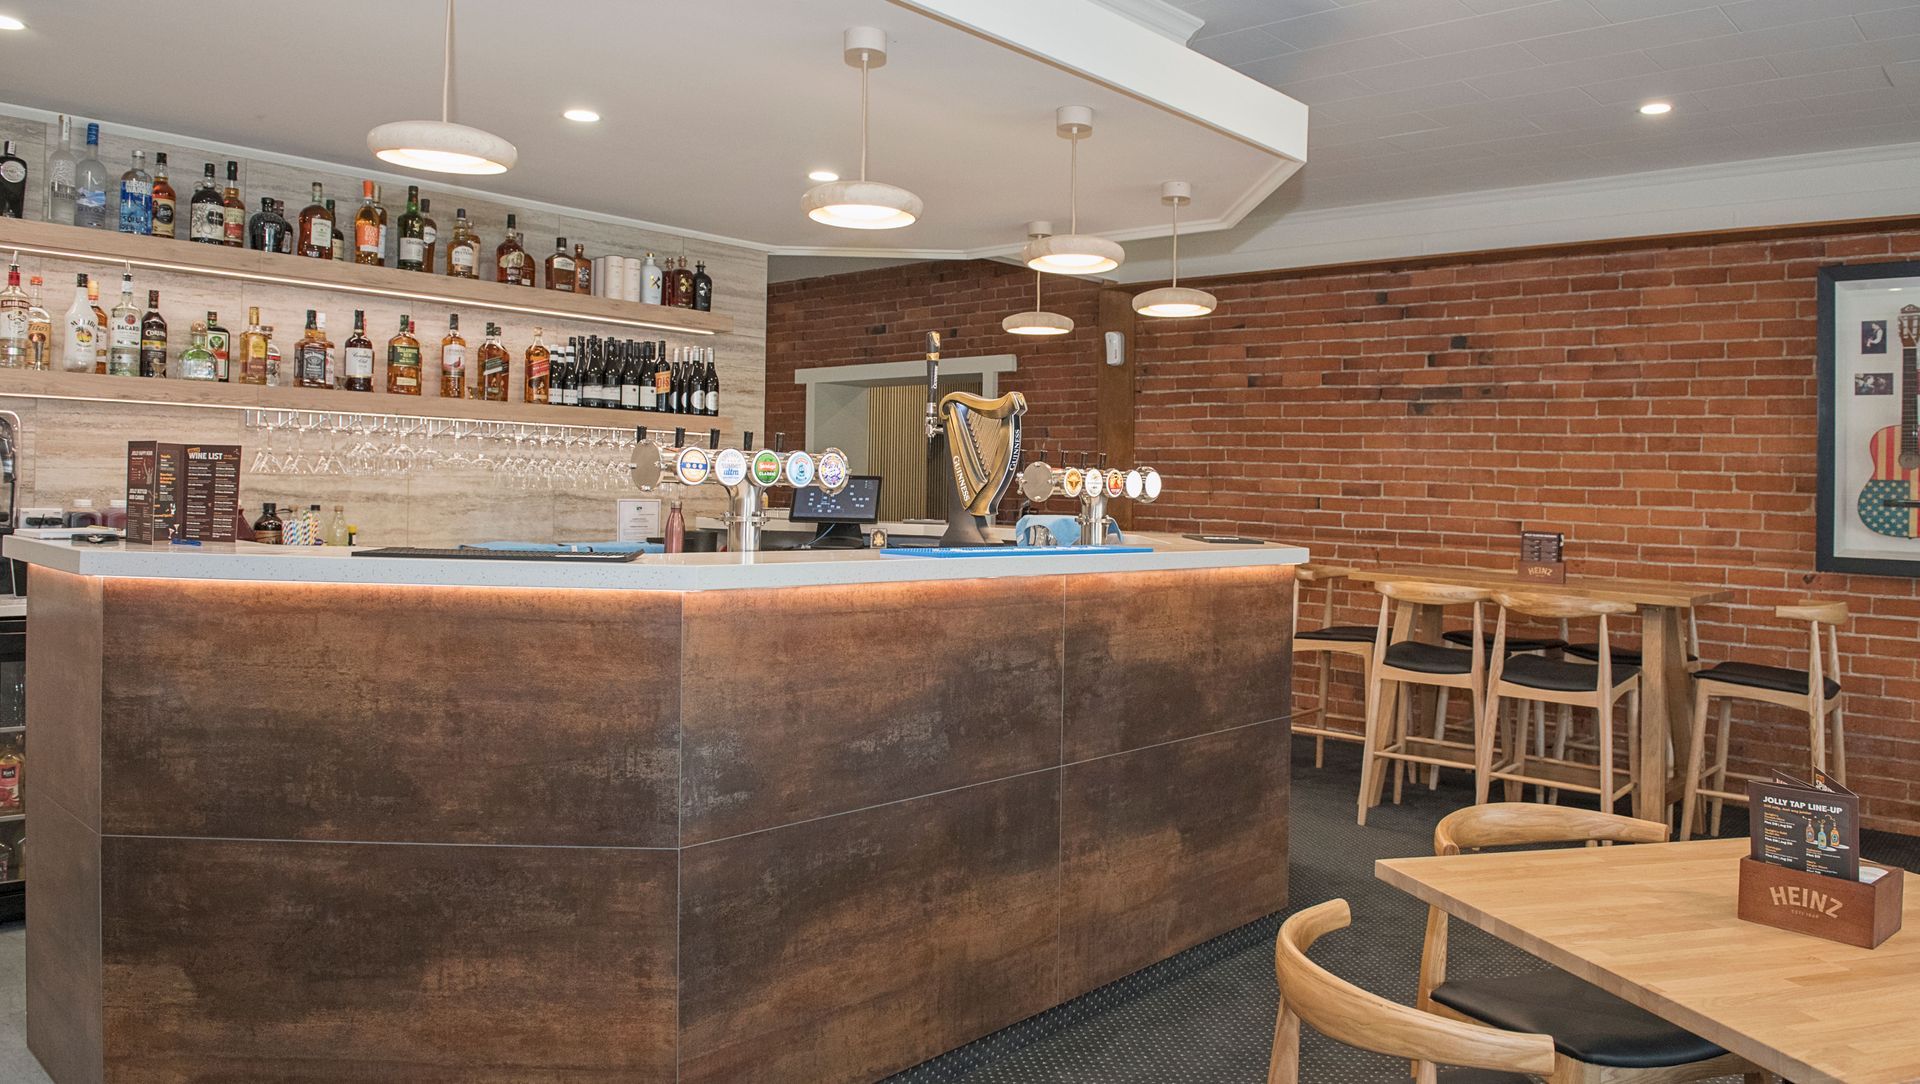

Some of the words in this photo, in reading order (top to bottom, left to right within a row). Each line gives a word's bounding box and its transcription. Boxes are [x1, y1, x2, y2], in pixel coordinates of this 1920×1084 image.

[1008, 429, 1021, 471] GUINNESS
[953, 455, 971, 502] GUINNESS
[1527, 566, 1553, 576] HEINZ
[1763, 796, 1787, 806] JOLLY
[1789, 800, 1806, 809] TAP
[1807, 803, 1843, 814] LINE-UP
[1769, 886, 1843, 918] HEINZ
